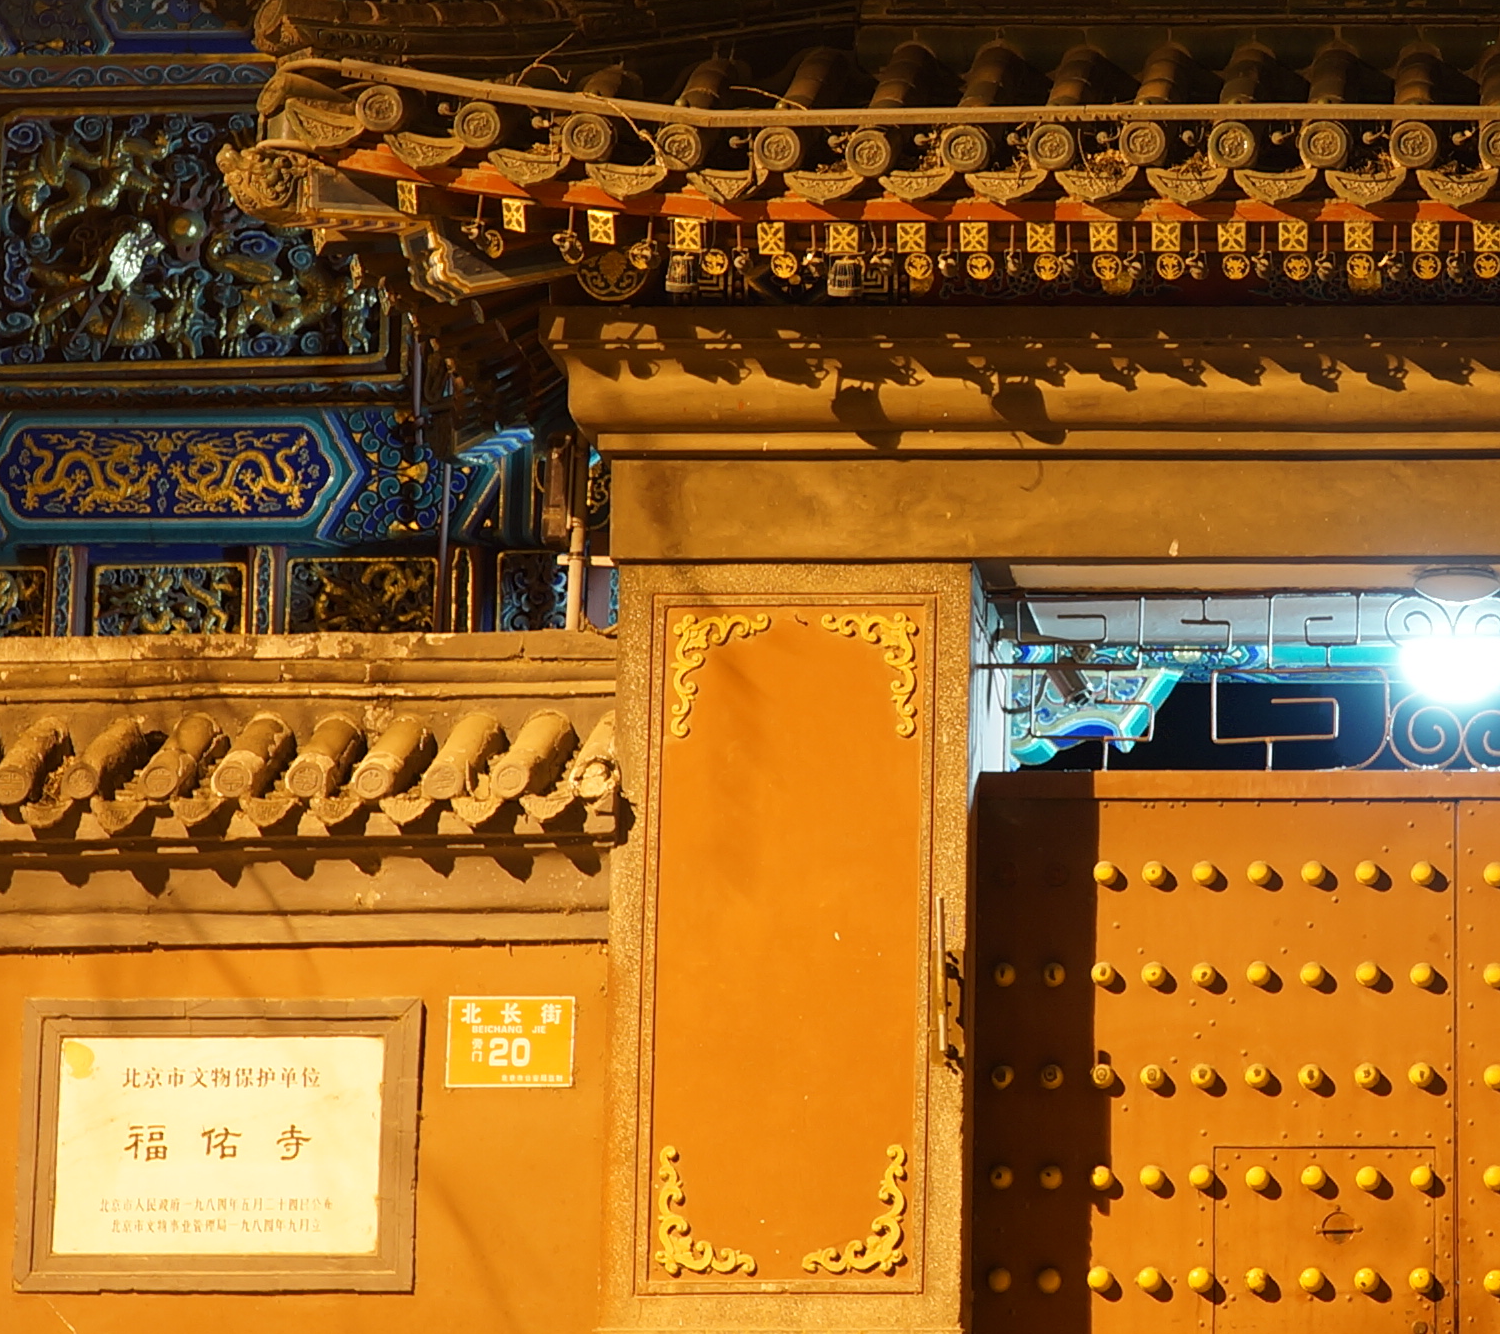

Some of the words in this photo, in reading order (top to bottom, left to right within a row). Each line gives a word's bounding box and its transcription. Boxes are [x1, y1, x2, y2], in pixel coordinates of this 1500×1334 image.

[460, 1002, 563, 1024] 北长街
[471, 1025, 523, 1034] BEICHANG
[531, 1025, 547, 1034] JIE
[488, 1037, 531, 1067] 20
[122, 1066, 321, 1089] 北京市文物保护单位
[124, 1124, 312, 1162] 福佑寺
